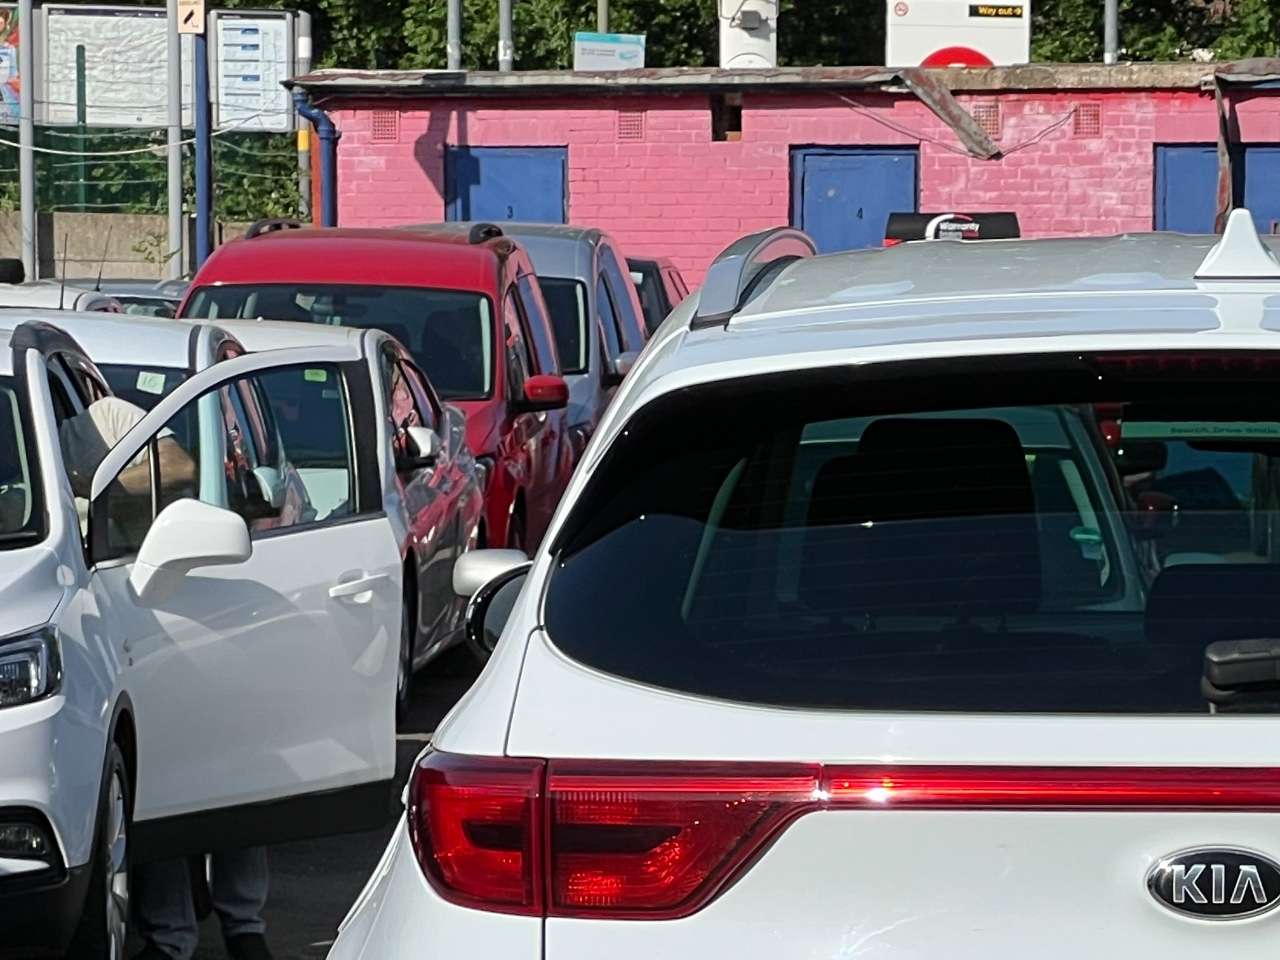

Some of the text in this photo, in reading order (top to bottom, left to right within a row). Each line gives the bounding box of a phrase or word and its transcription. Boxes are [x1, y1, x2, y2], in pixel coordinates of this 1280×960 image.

[978, 6, 997, 16] Way
[507, 205, 514, 219] 3
[856, 207, 863, 220] 4
[1172, 864, 1268, 904] KIA
